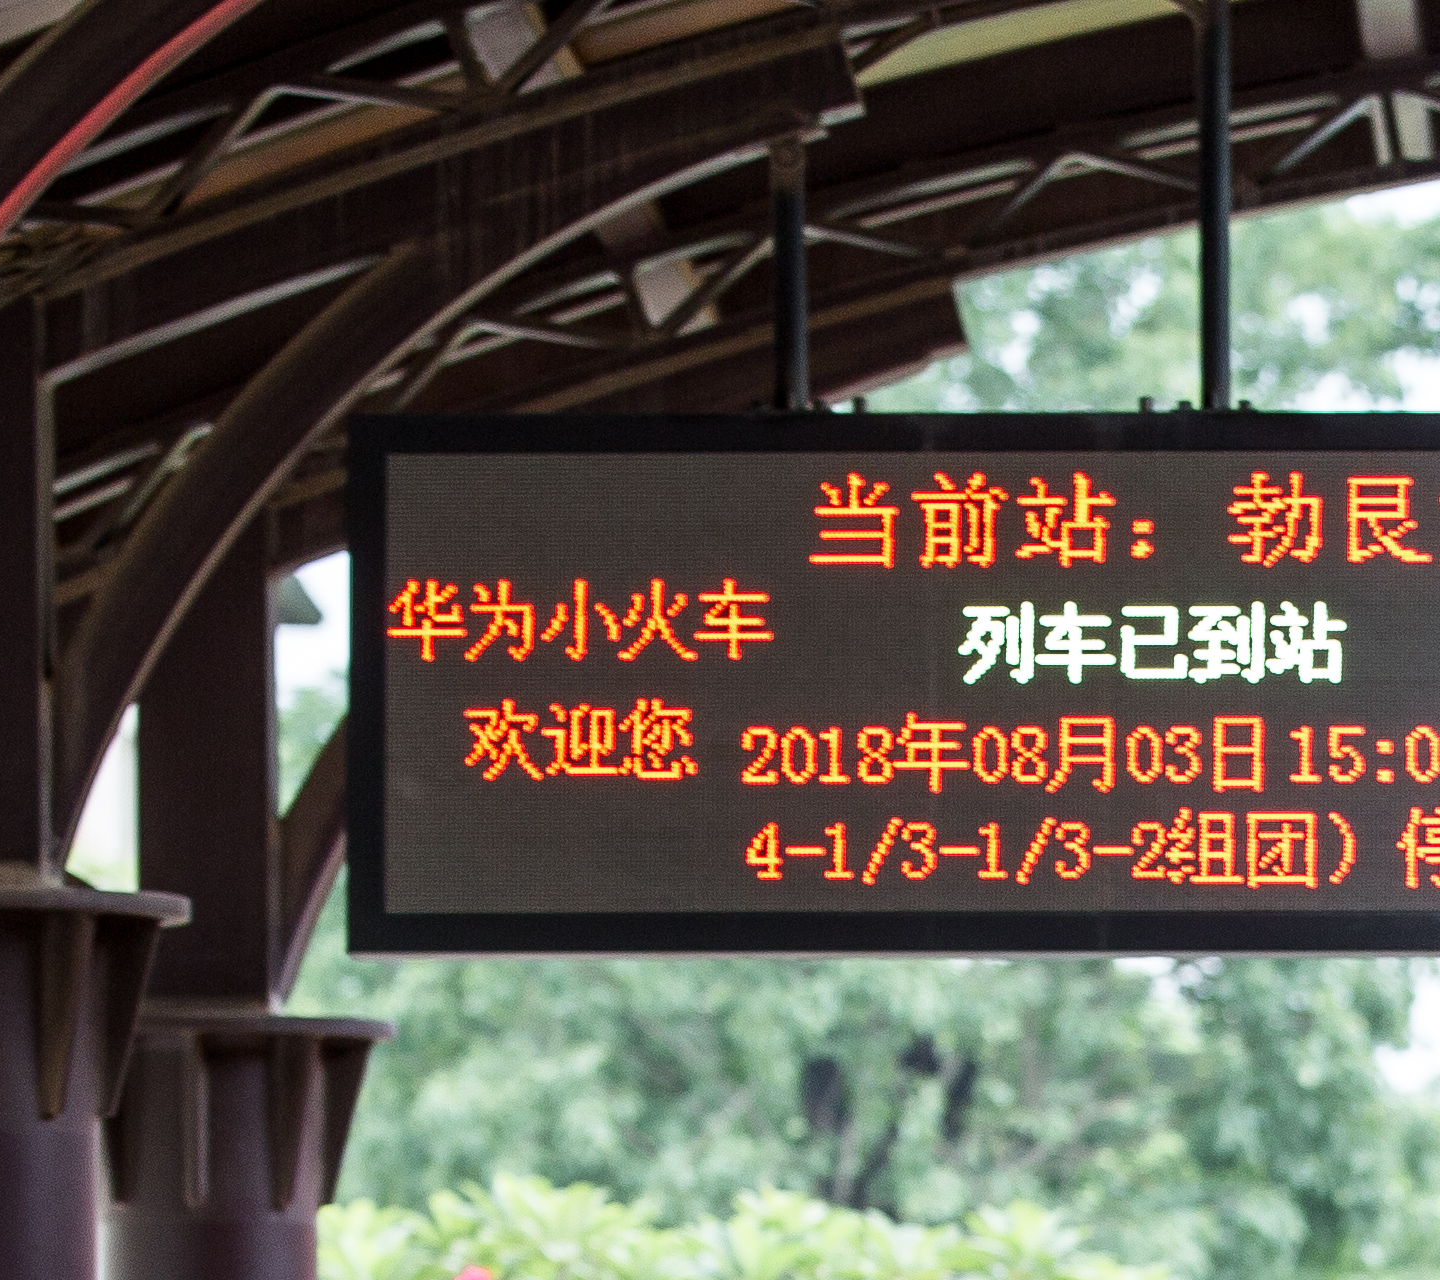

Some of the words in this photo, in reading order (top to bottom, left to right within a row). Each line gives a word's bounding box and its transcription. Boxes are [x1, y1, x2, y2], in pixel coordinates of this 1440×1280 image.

[386, 577, 775, 663] 华为小火车
[957, 600, 1348, 685] 列车已到站
[462, 697, 699, 782] 欢迎您
[740, 712, 1266, 795] 2018年08月03日
